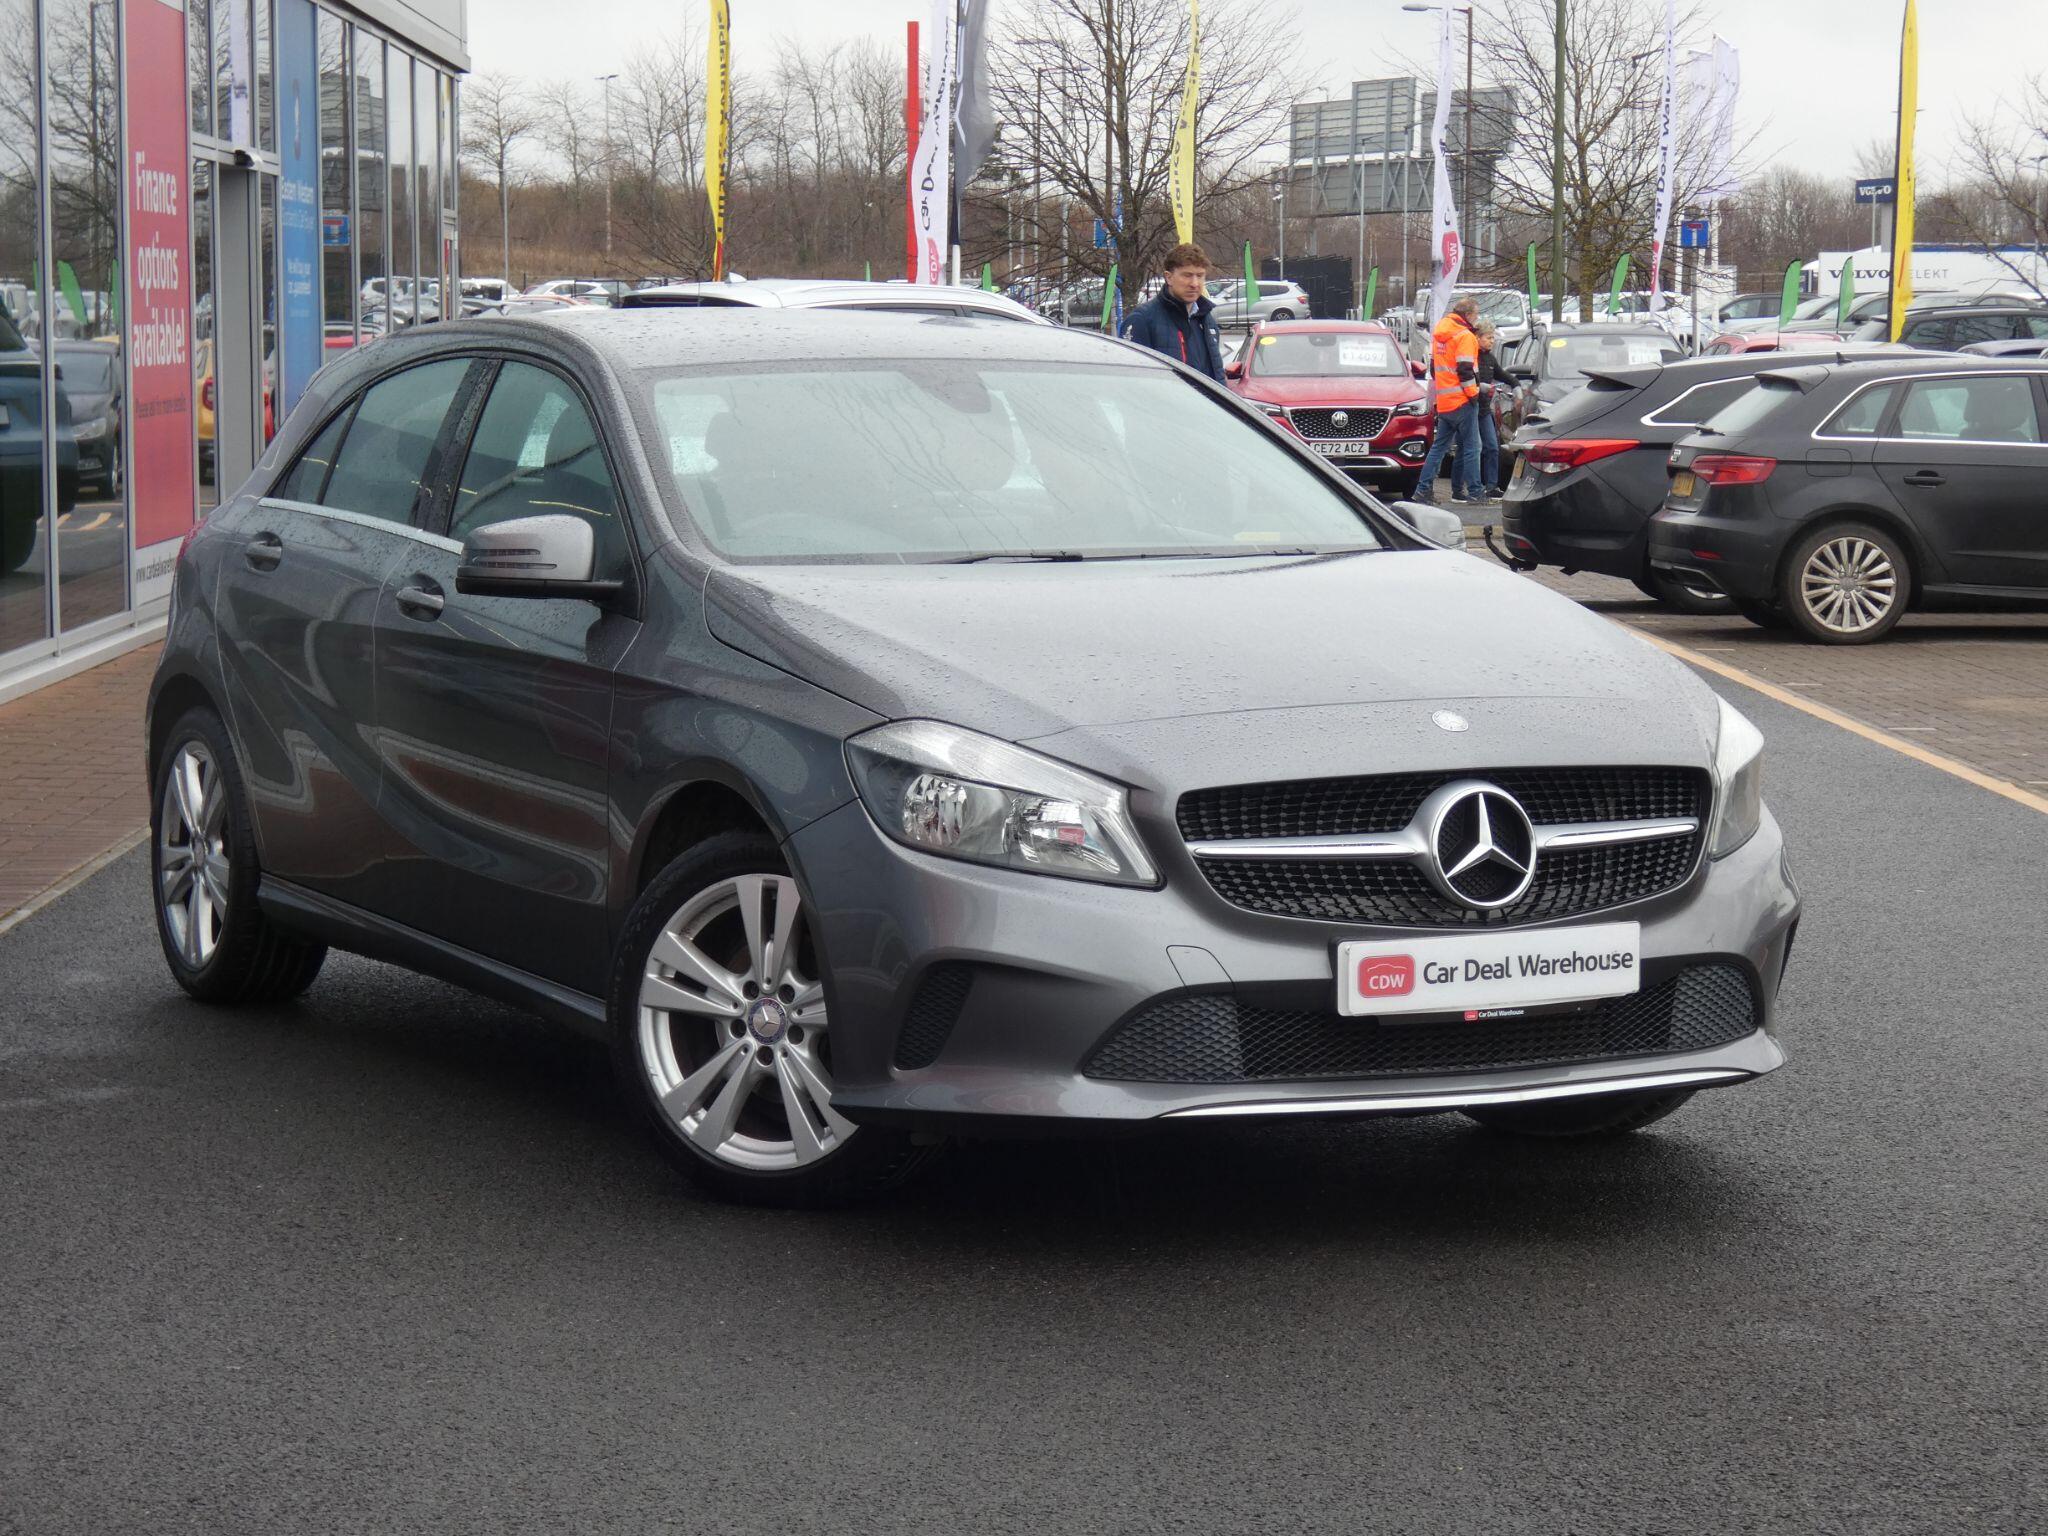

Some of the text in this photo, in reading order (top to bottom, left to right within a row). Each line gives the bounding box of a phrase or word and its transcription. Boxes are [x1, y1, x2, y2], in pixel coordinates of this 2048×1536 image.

[135, 150, 177, 216] Finance
[137, 231, 178, 307] options
[1828, 269, 1891, 279] VLVO
[133, 308, 186, 368] available!
[1313, 443, 1365, 454] CE72 ACZ
[1368, 973, 1405, 991] CDW
[1423, 950, 1634, 985] Car Deal Warehouse
